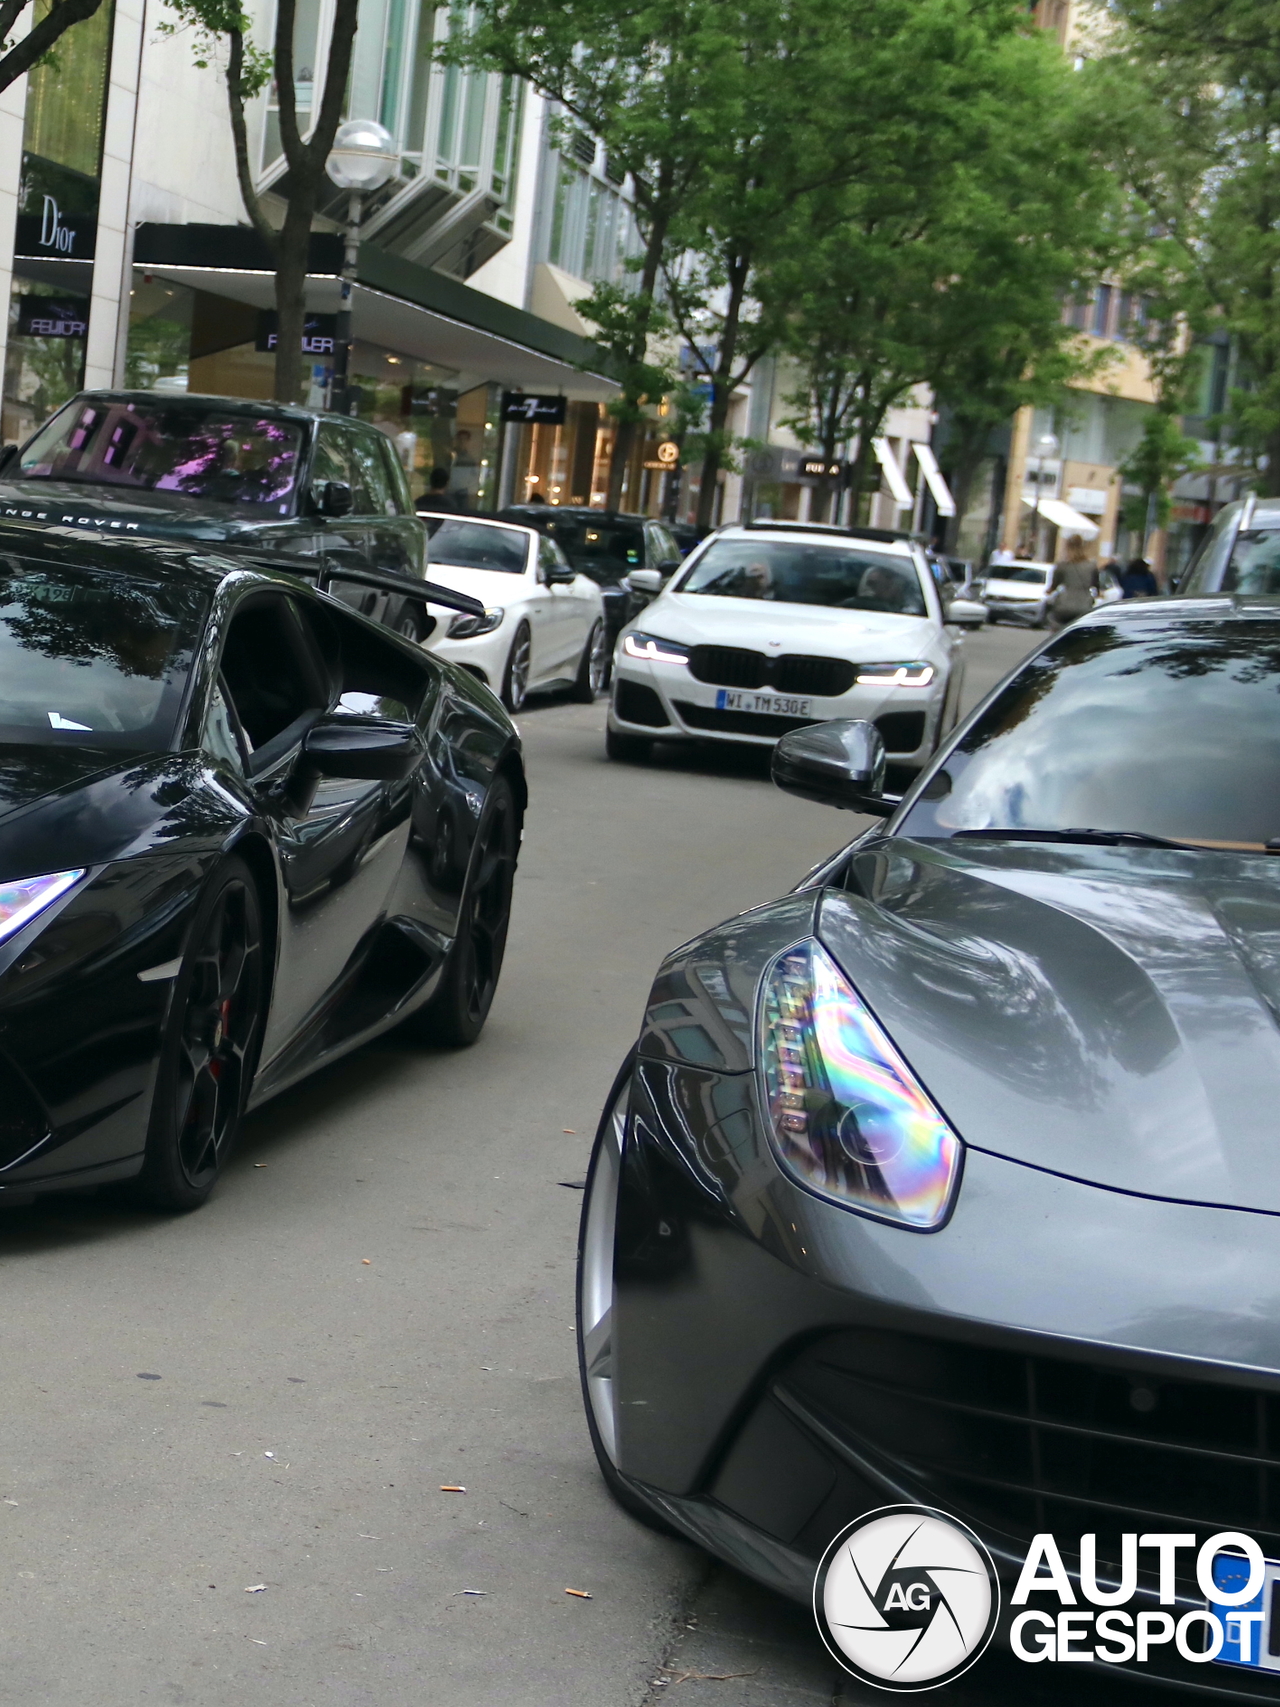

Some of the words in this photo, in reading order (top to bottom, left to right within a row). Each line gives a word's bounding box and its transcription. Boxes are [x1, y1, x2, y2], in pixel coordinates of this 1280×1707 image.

[38, 194, 76, 253] Dior
[62, 515, 139, 530] ROVER
[727, 693, 742, 708] WI
